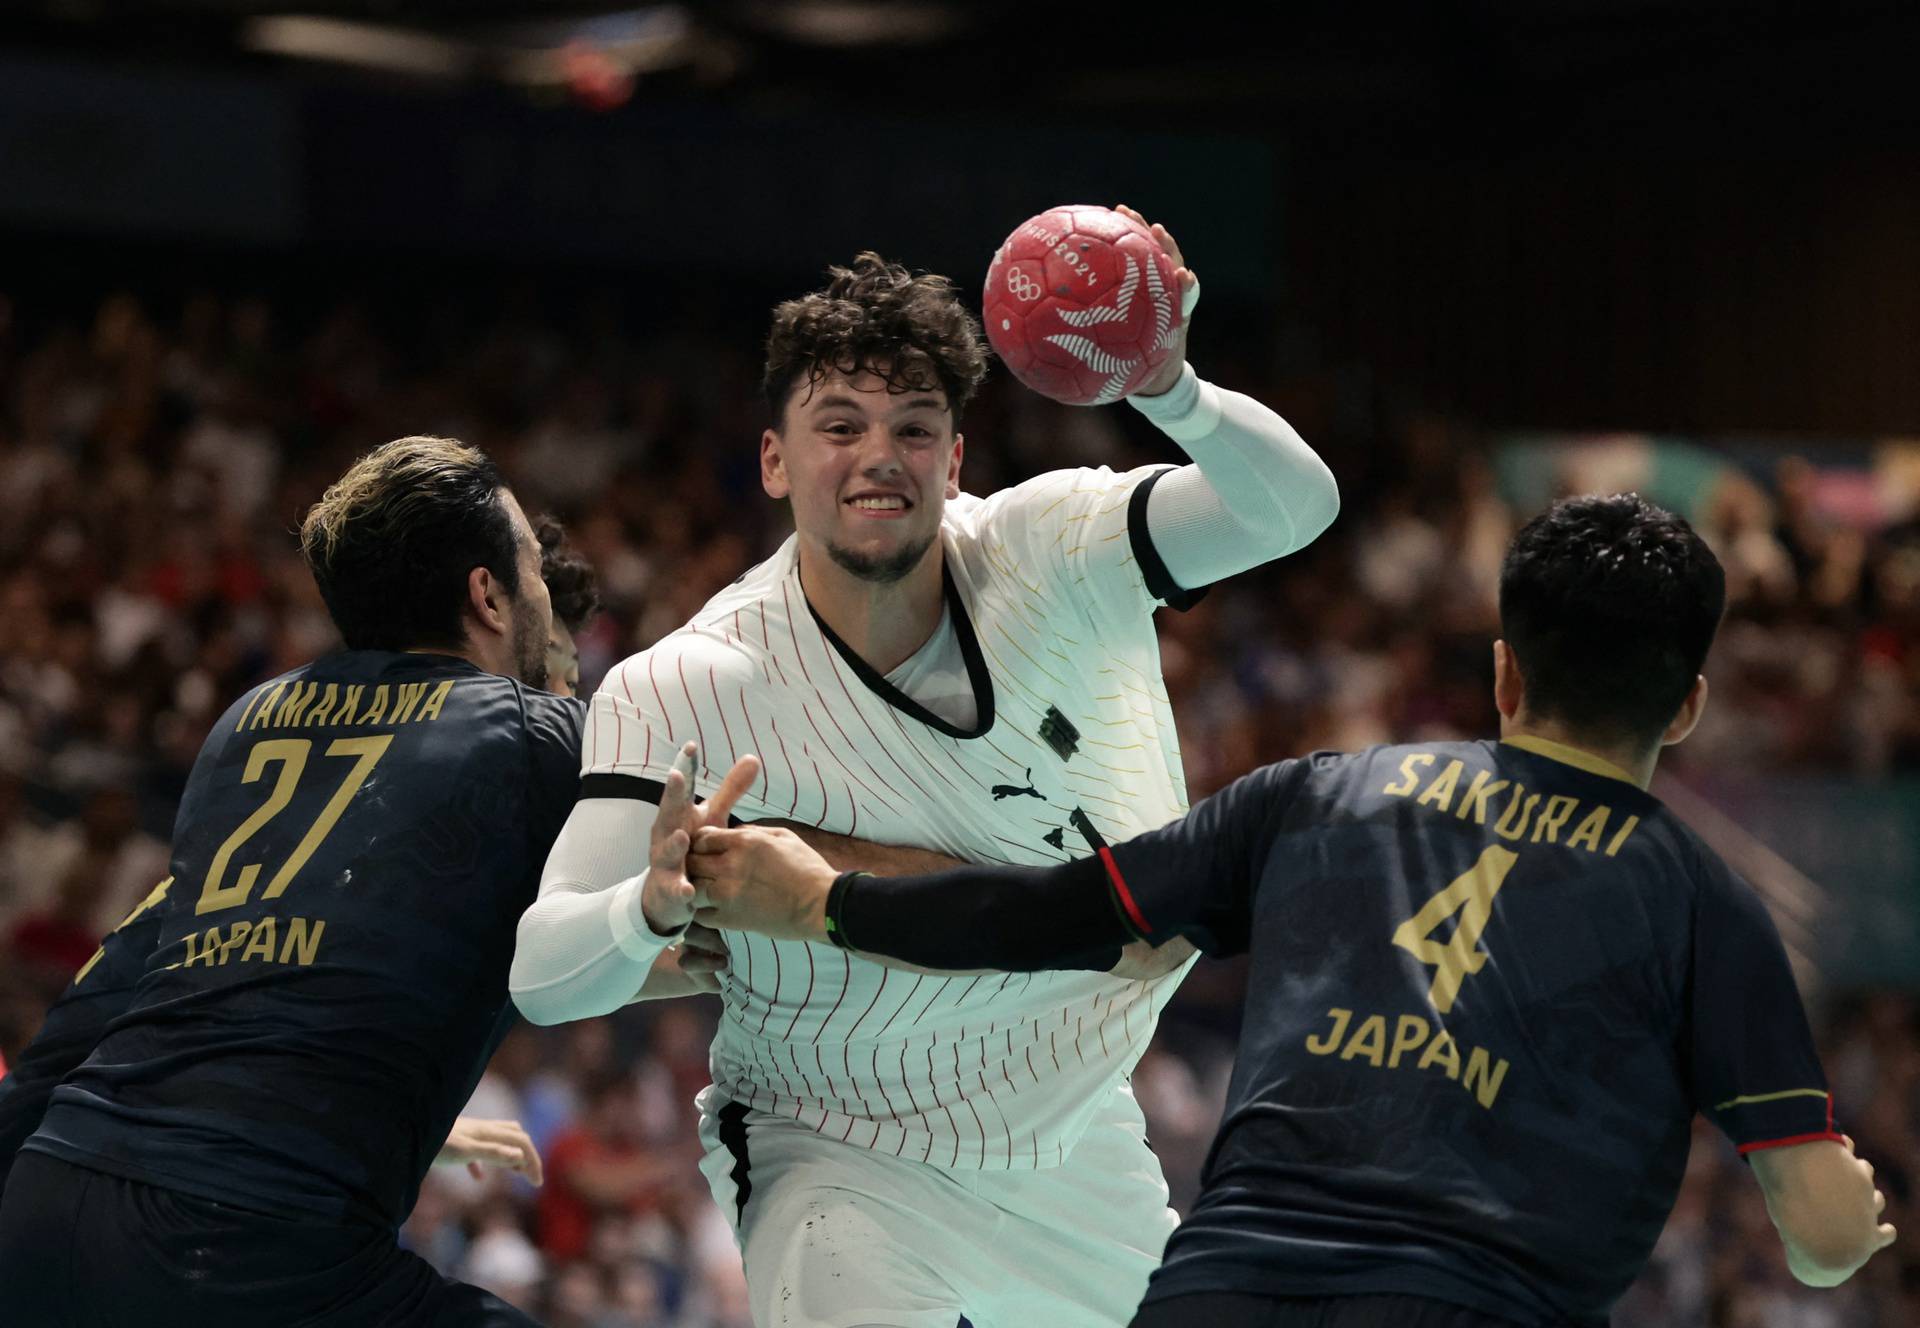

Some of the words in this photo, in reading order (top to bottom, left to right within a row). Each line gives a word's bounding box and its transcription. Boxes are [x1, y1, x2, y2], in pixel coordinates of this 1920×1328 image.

[1055, 243, 1097, 286] 2024
[235, 680, 456, 732] TAMAKAWA
[195, 734, 395, 916] 27
[1383, 753, 1640, 857] SAKURAI
[166, 916, 327, 970] JAPAN
[1392, 843, 1520, 1014] 4
[1305, 1007, 1511, 1110] JAPAN
